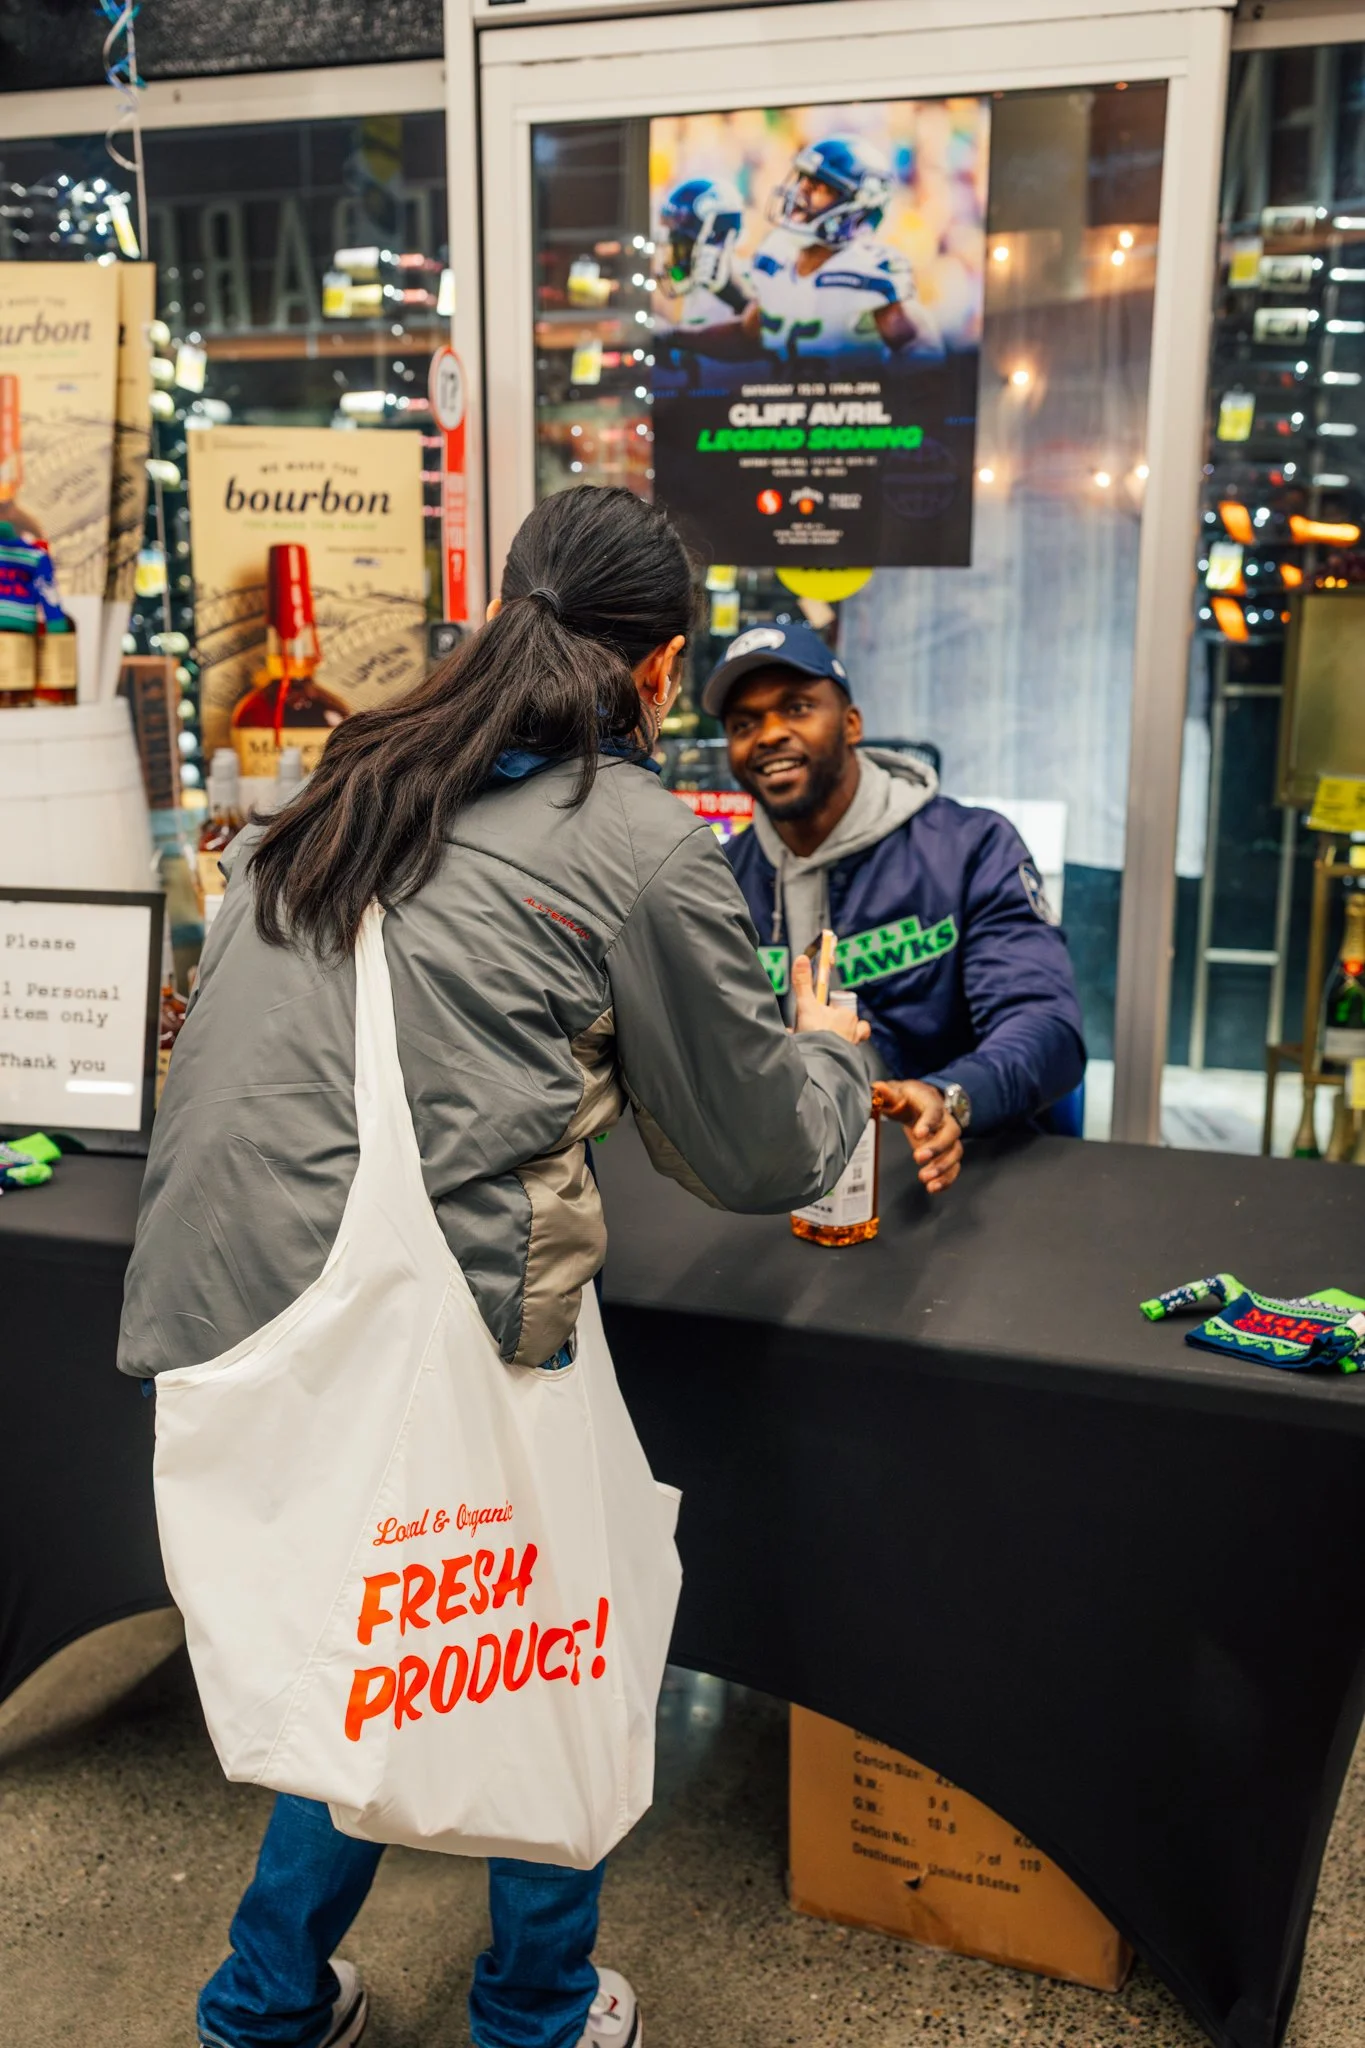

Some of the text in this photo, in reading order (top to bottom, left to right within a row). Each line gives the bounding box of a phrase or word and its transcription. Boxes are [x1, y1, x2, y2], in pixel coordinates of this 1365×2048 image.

[728, 401, 892, 427] CLIFF AVRIL
[696, 425, 924, 452] LEGEND SIGNING
[224, 474, 392, 515] bourbon
[5, 933, 77, 951] Please
[26, 982, 121, 1001] Personal
[1, 1006, 109, 1029] item only
[69, 1058, 107, 1075] you
[433, 1509, 450, 1533] &
[357, 1543, 538, 1646] FRESH
[927, 1863, 973, 1884] United
[976, 1873, 1021, 1893] States
